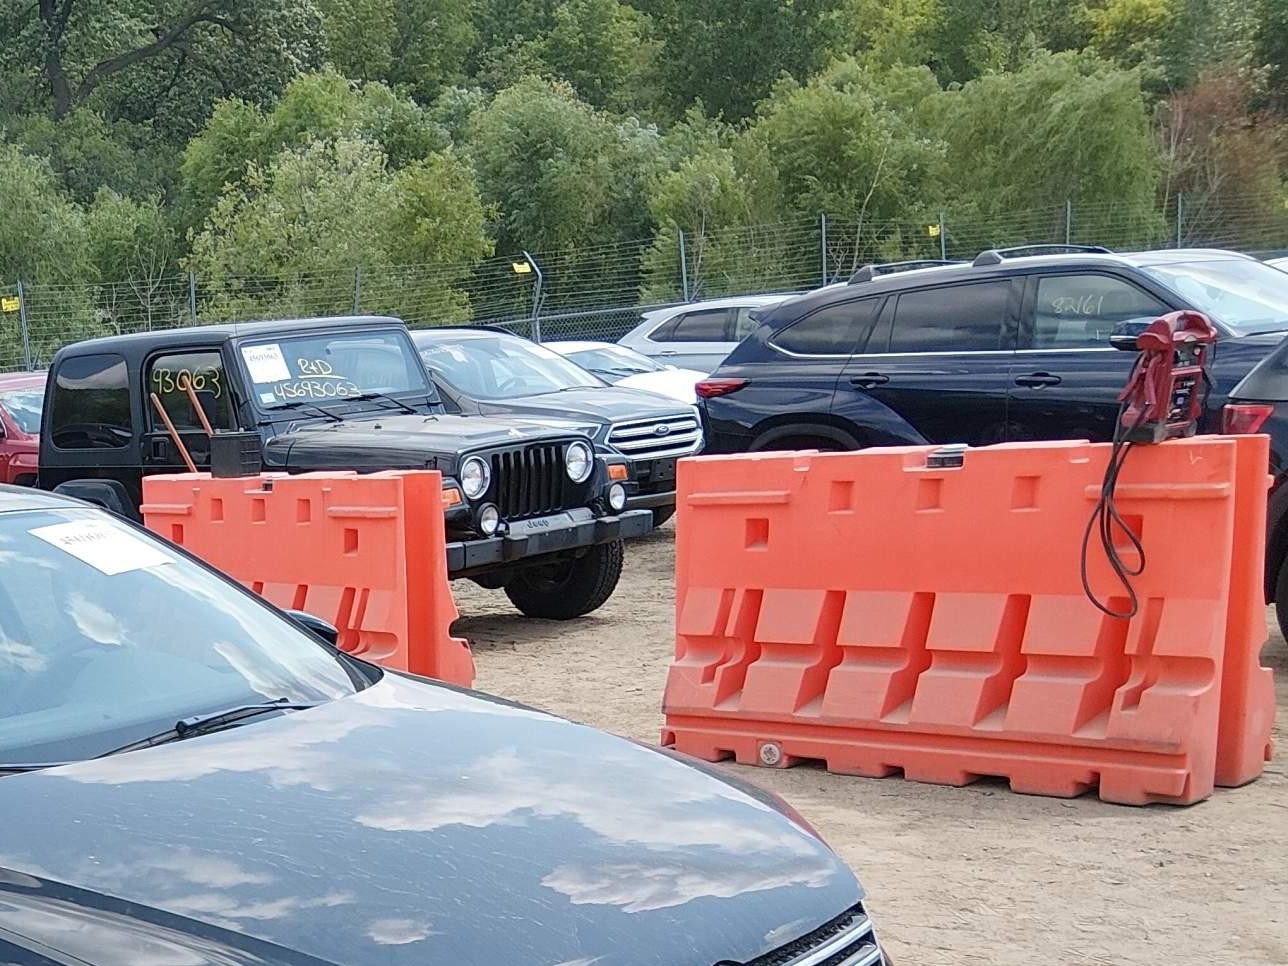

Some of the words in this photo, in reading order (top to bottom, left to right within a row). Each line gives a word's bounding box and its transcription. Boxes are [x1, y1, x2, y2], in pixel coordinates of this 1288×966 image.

[153, 366, 221, 399] 93063
[274, 380, 362, 400] 45693063
[527, 519, 550, 529] Jeep
